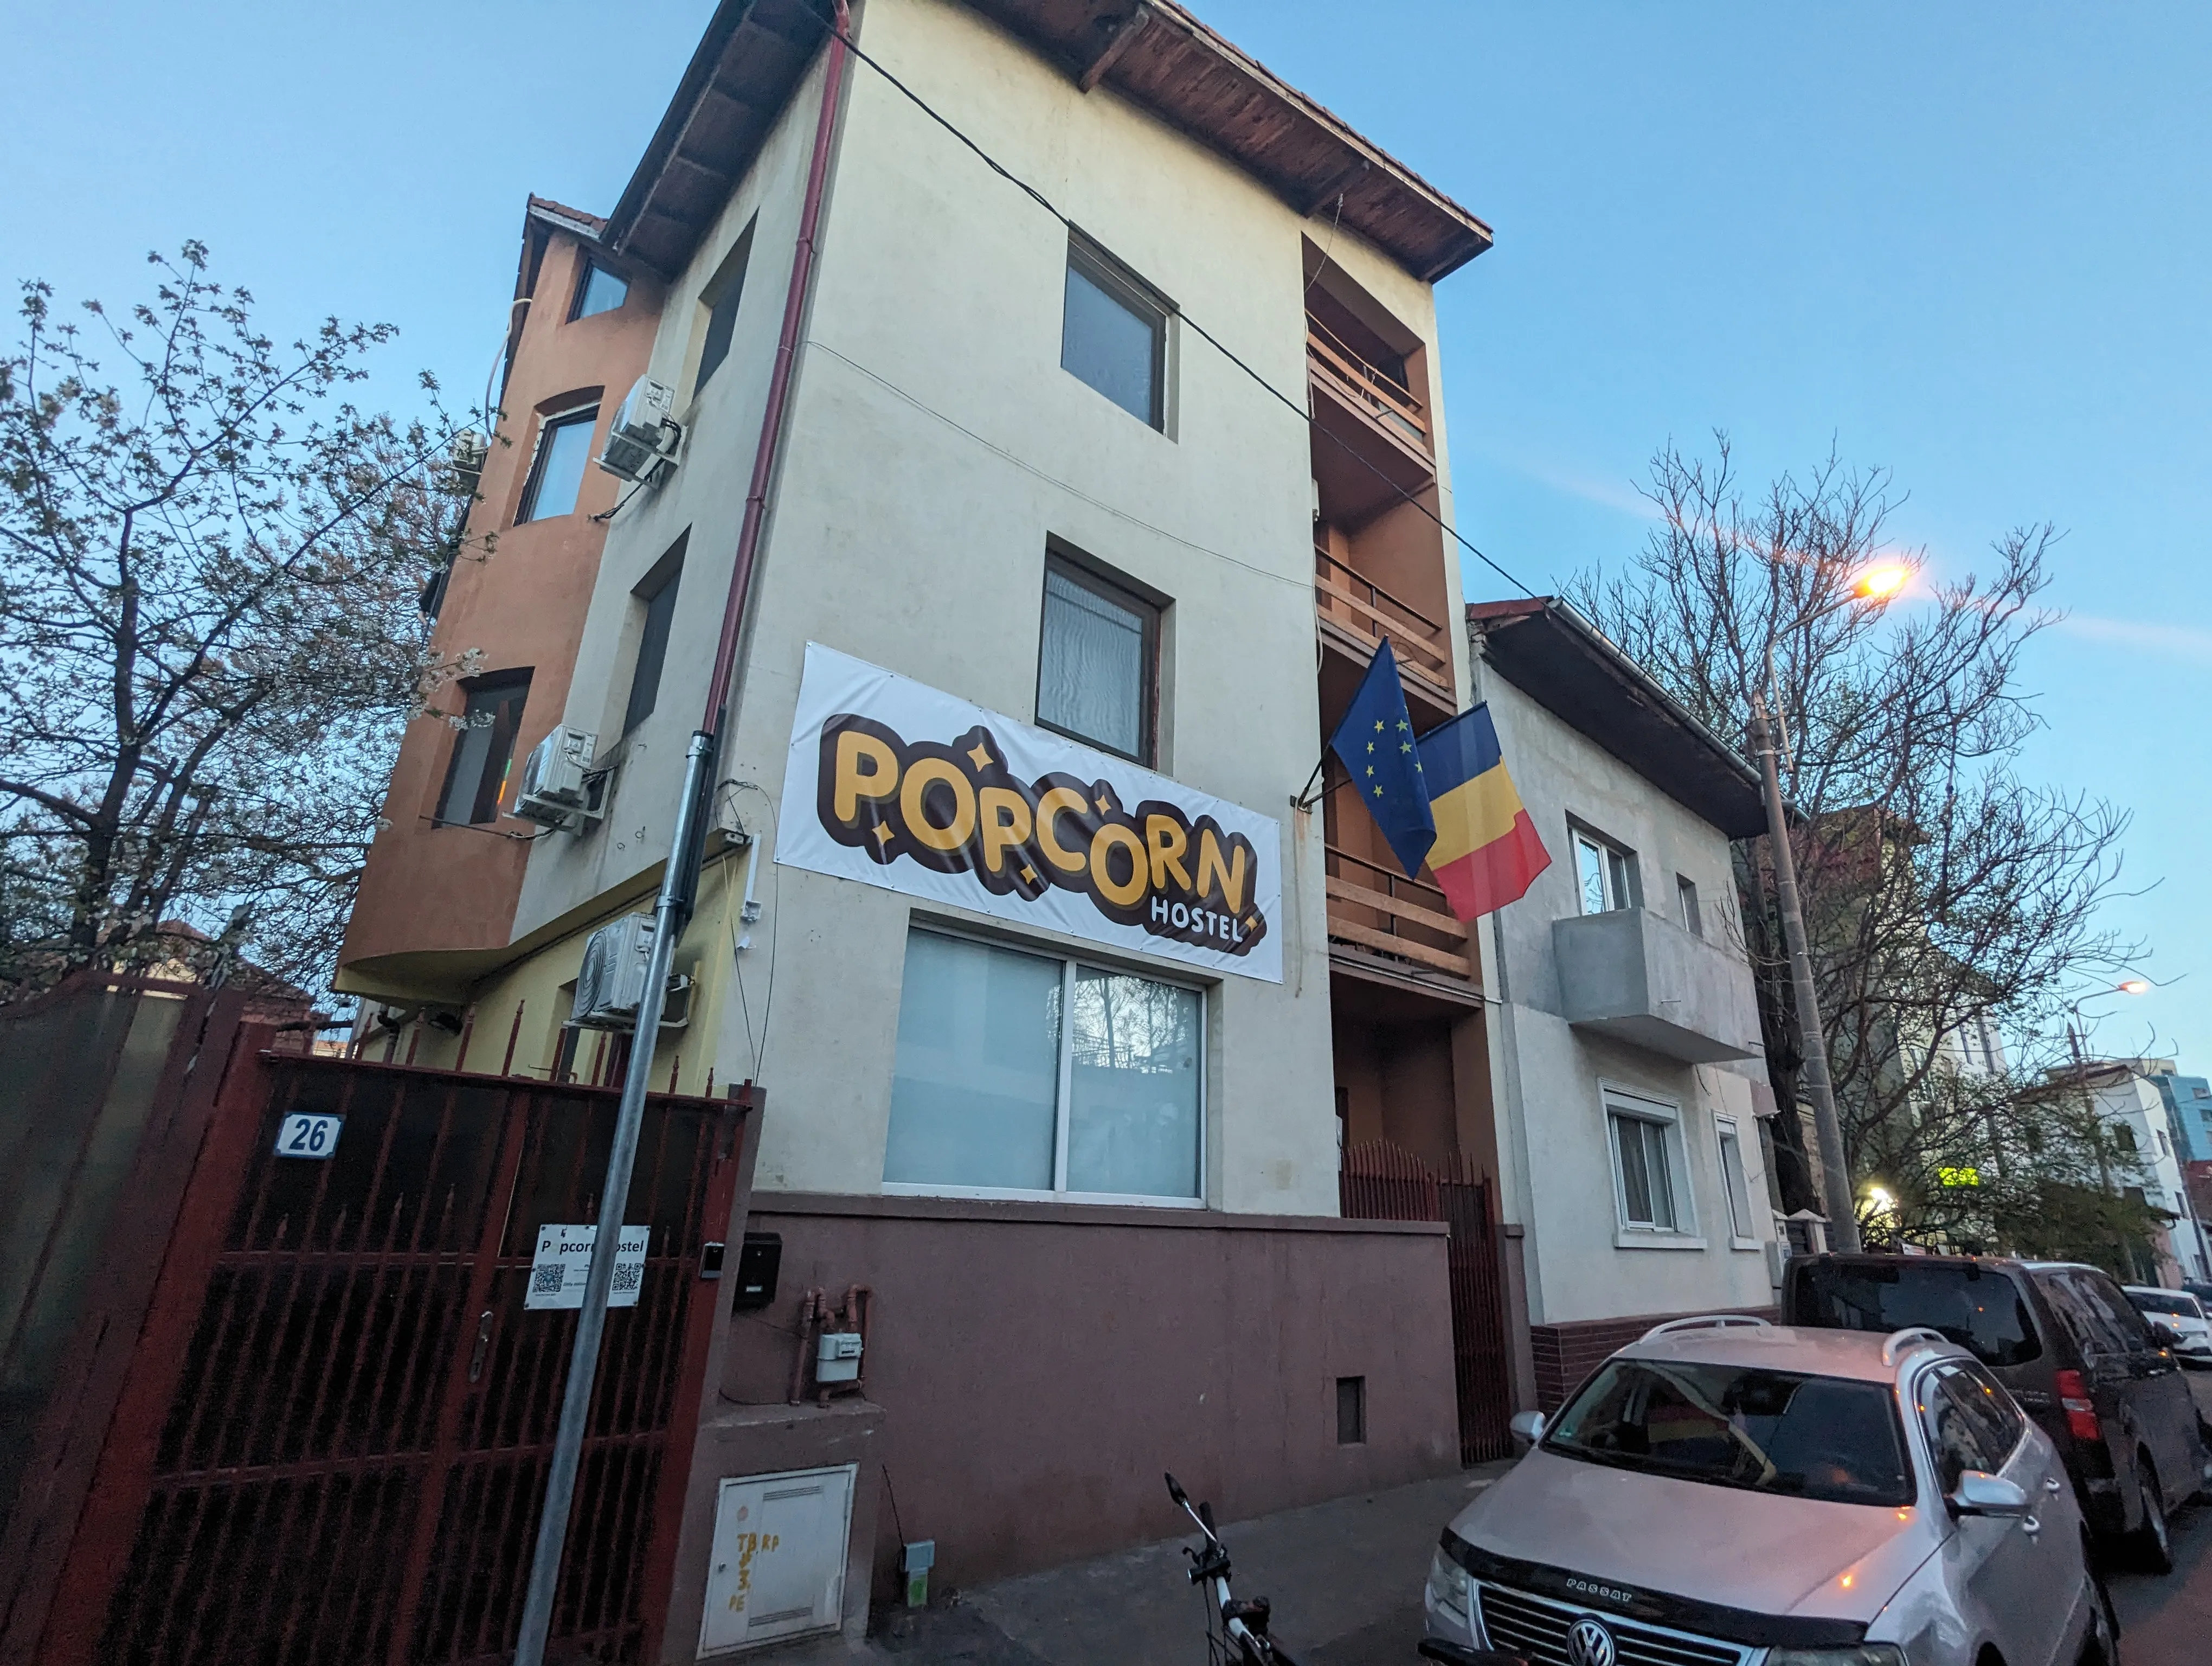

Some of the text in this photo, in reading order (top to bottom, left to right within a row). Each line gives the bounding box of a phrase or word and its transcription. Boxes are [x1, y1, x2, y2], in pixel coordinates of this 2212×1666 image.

[834, 730, 1245, 914] POPCORN
[1151, 895, 1243, 943] HOSTEL
[288, 1118, 329, 1151] 26
[1566, 1578, 1632, 1602] PASSAT
